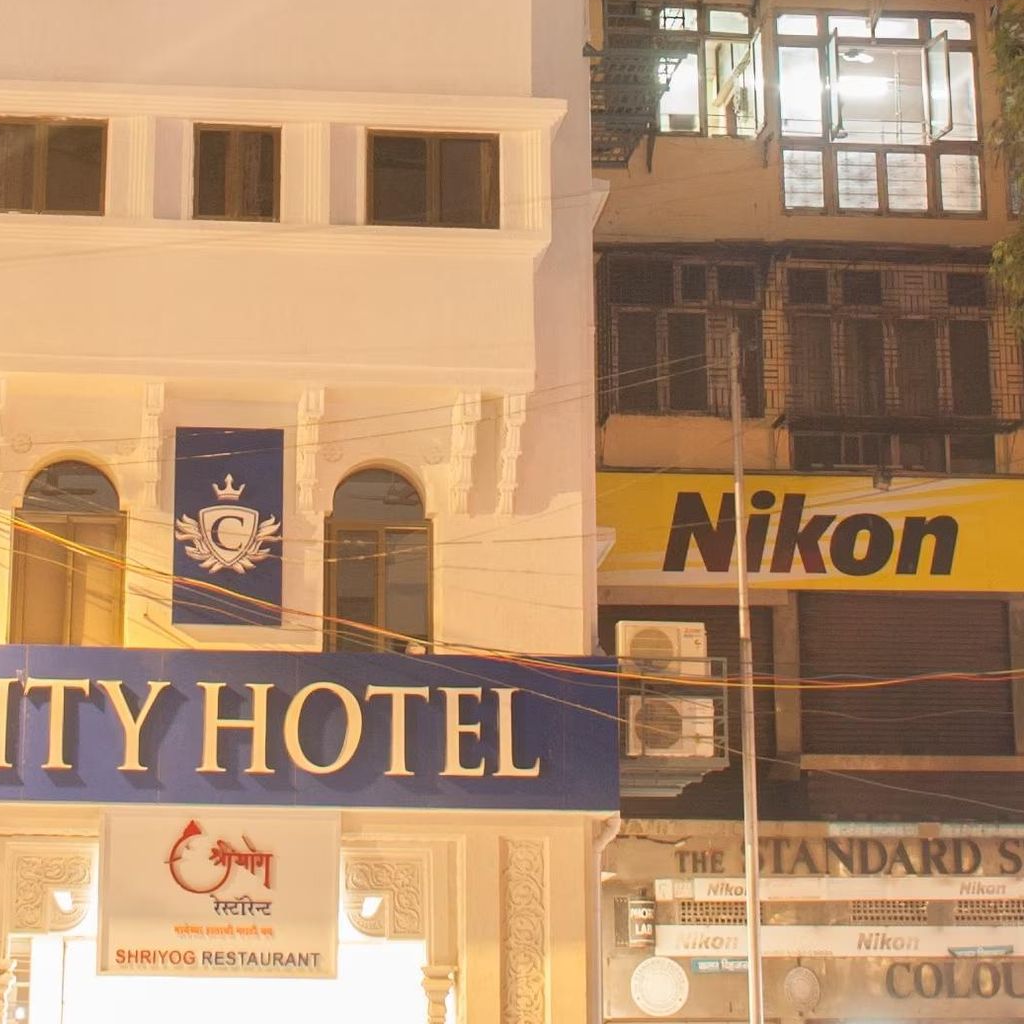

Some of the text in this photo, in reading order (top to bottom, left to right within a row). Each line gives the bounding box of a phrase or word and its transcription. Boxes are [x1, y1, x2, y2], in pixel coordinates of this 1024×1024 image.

[211, 516, 244, 551] C
[663, 490, 959, 575] Nikon
[194, 682, 541, 777] HOTEL
[677, 850, 724, 874] THE
[999, 838, 1024, 875] S
[707, 883, 747, 896] Niko
[959, 881, 1007, 896] Nikon
[857, 933, 920, 951] Nikon
[116, 949, 320, 968] SHRIYOG RESTAURANT
